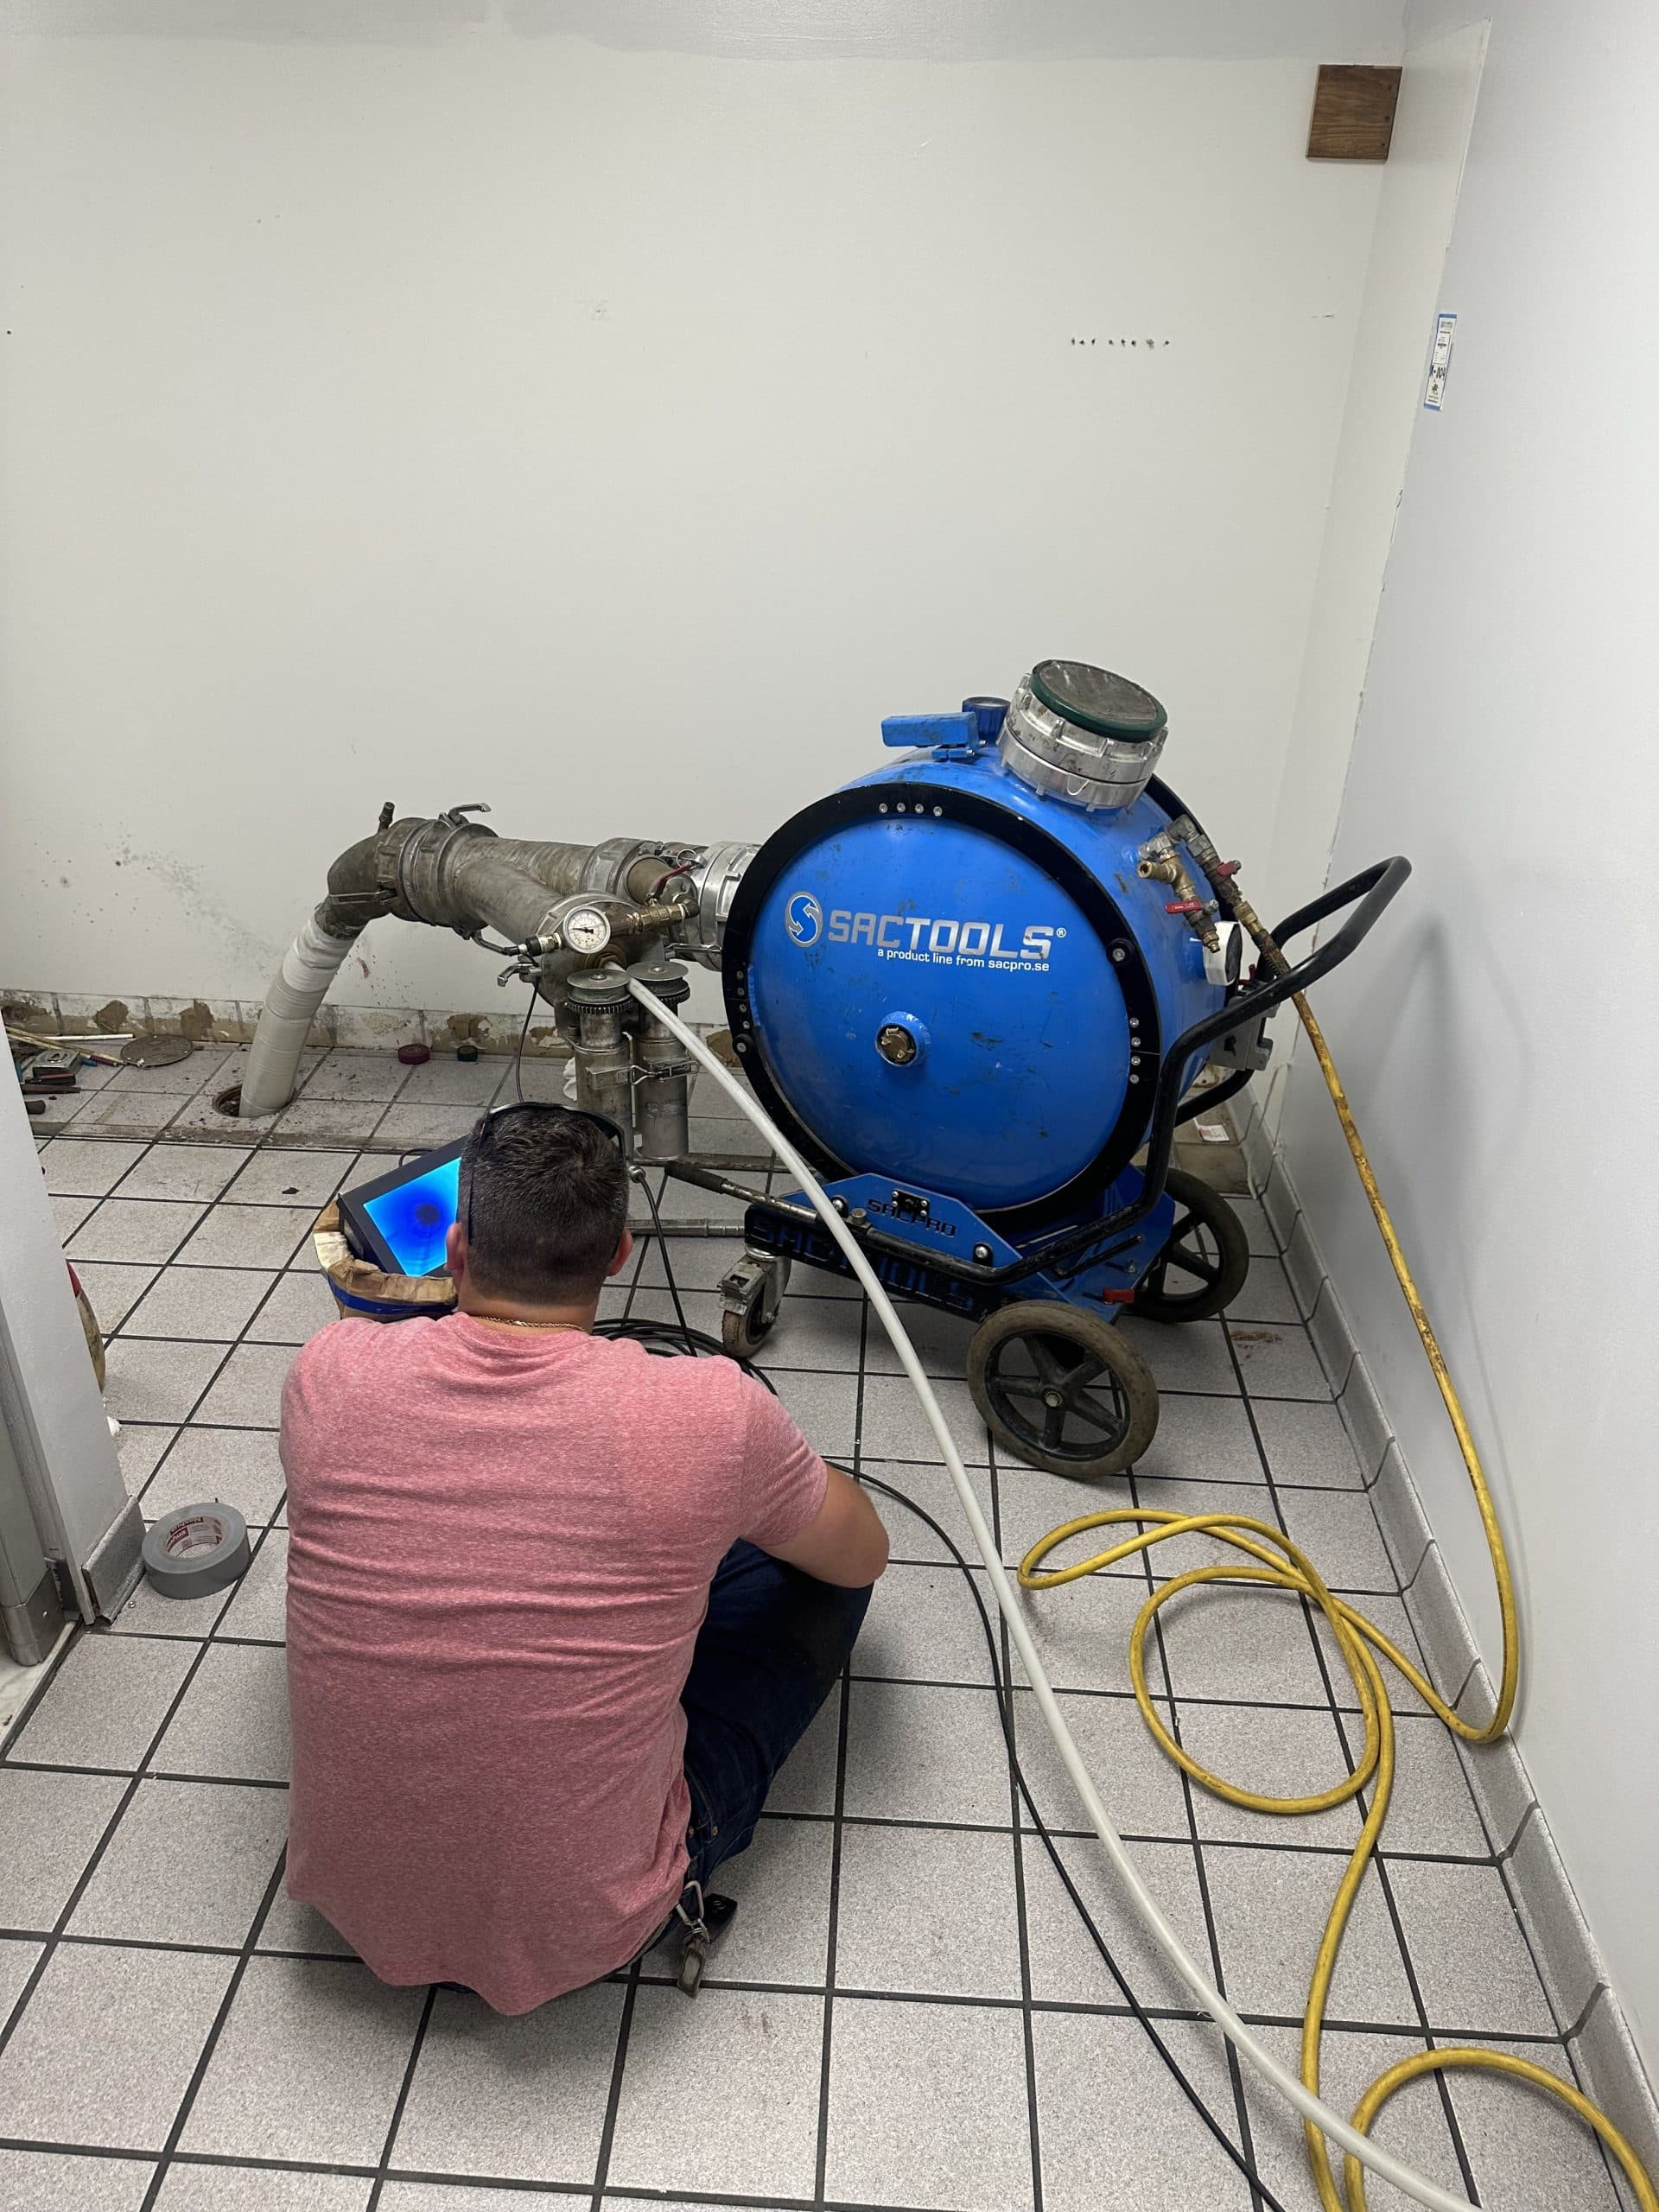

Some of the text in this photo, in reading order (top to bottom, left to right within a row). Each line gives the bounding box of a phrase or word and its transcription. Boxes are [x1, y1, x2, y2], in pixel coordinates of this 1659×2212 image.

[887, 950, 931, 963] product
[933, 952, 954, 965] line
[956, 955, 985, 969] from
[988, 959, 1051, 972] sacpro.se
